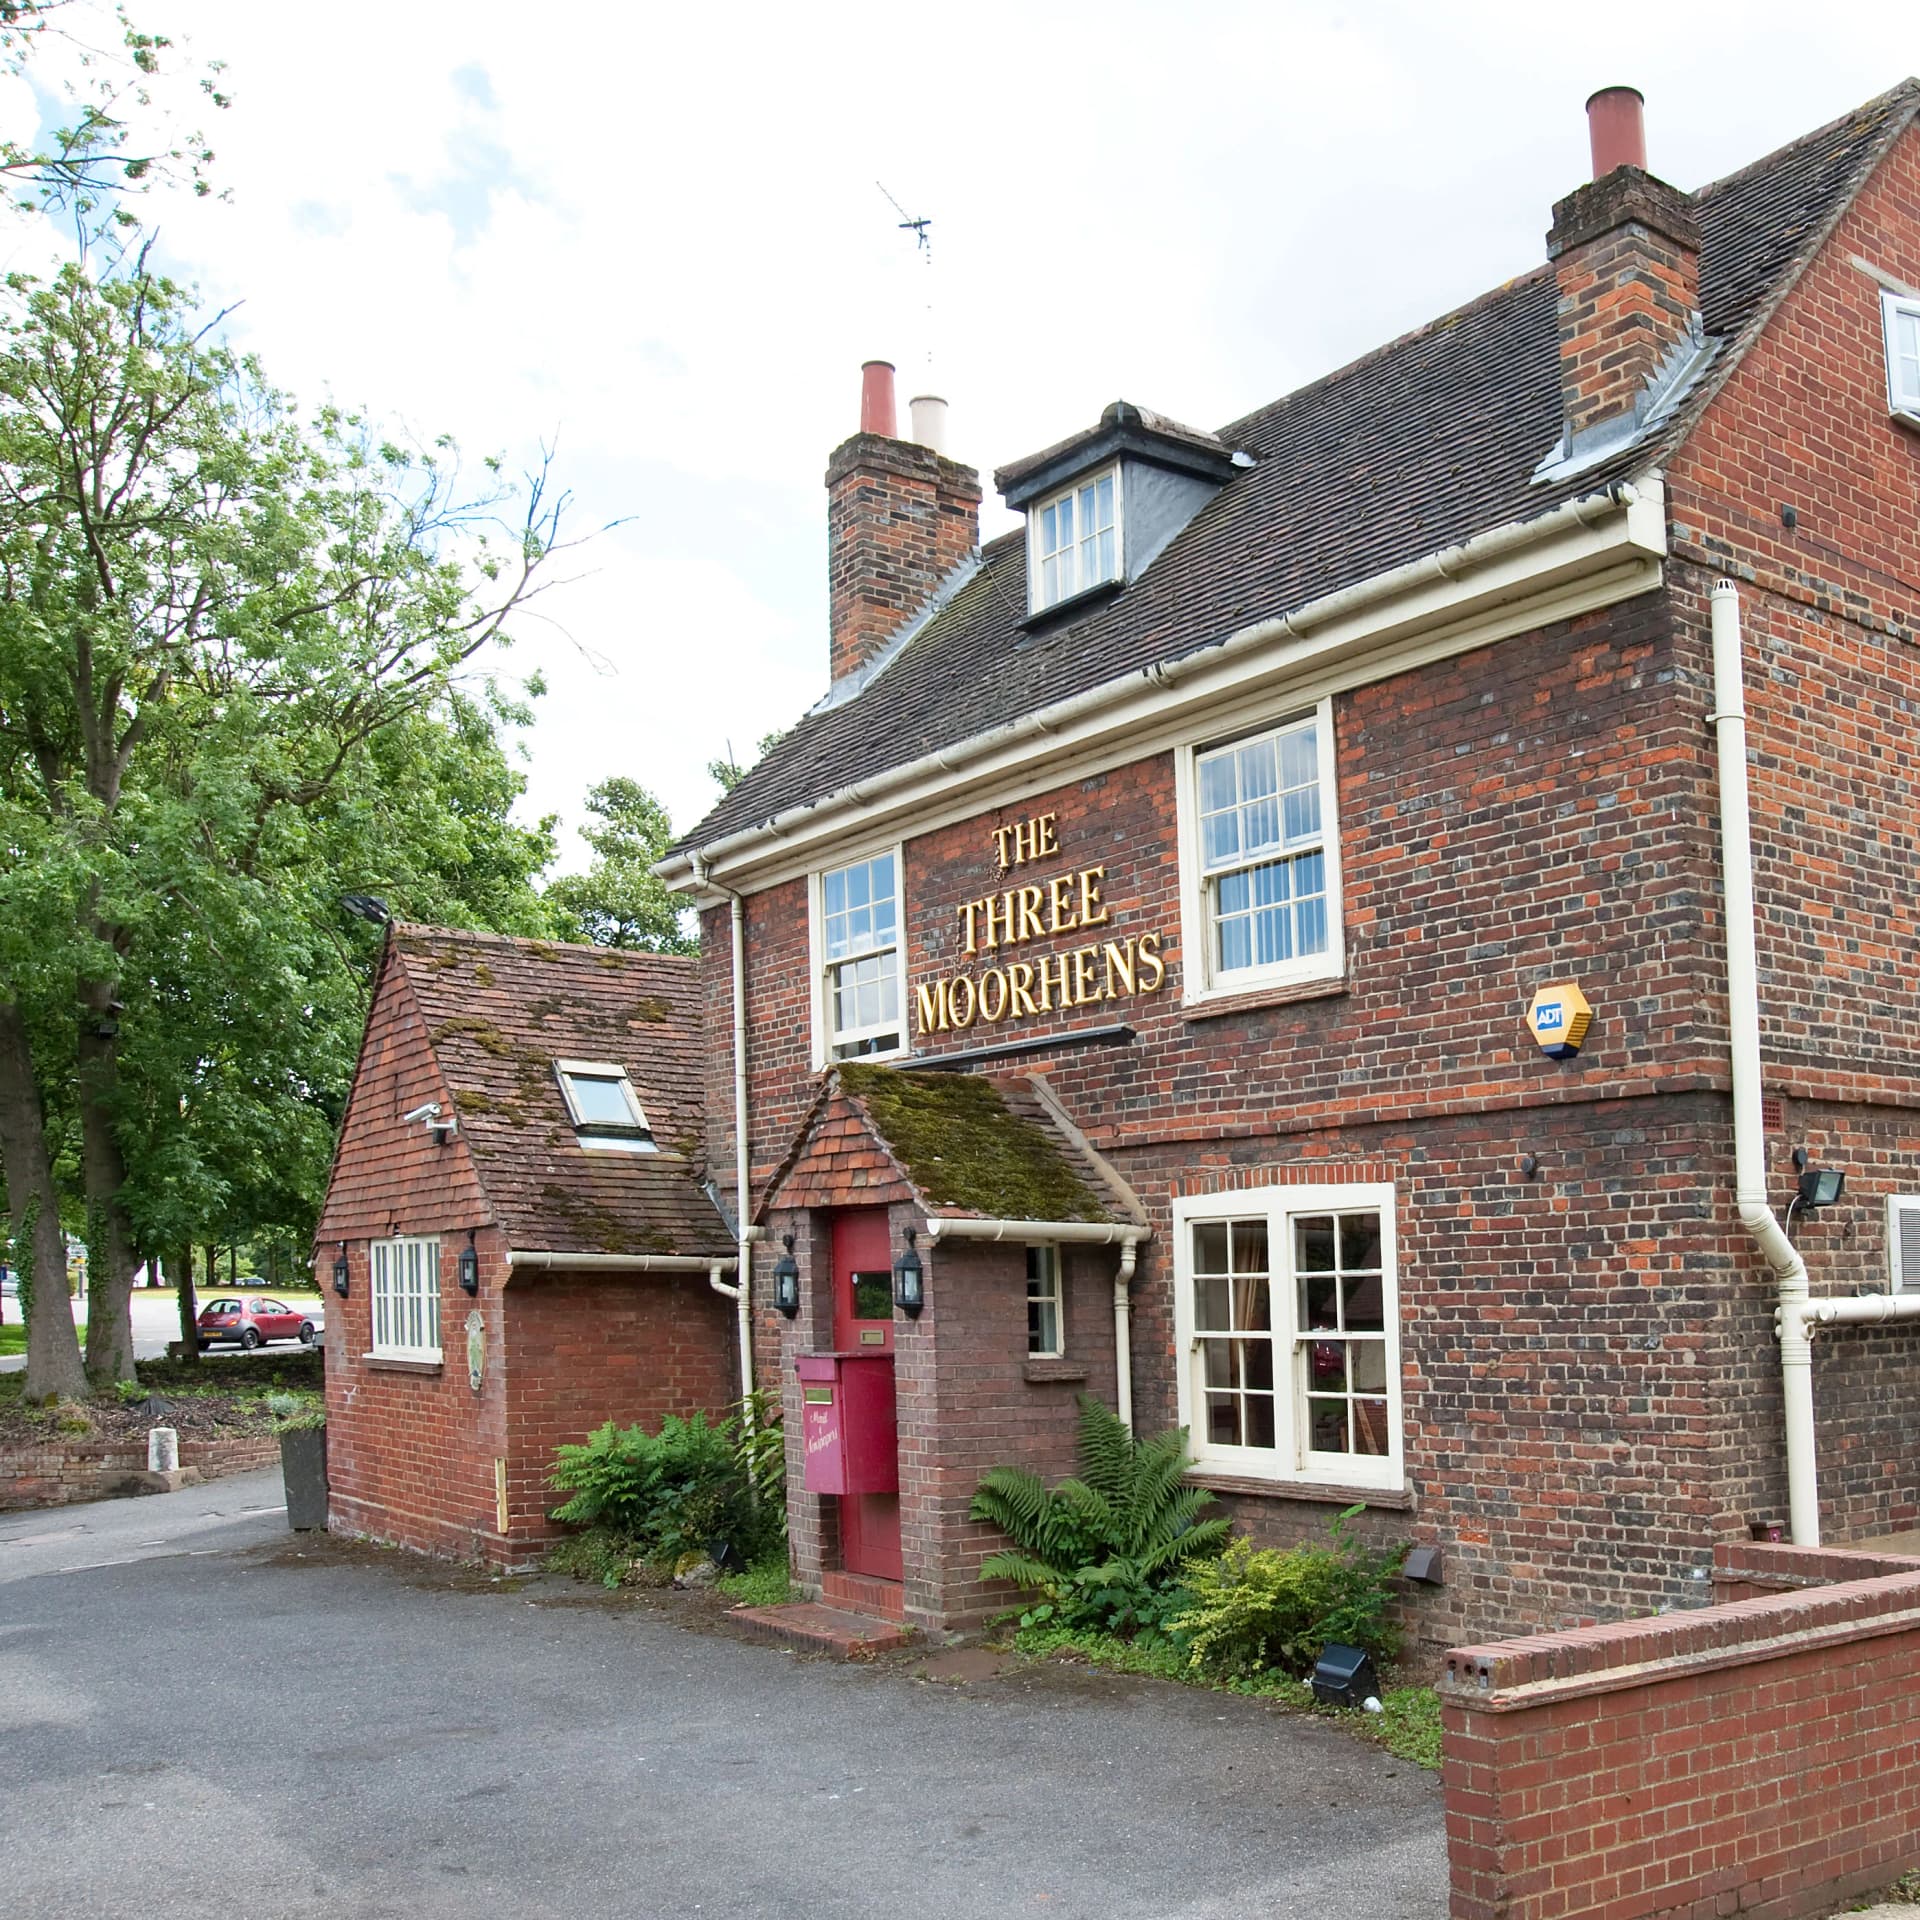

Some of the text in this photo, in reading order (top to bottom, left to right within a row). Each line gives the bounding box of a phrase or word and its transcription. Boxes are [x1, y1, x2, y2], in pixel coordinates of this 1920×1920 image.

[991, 812, 1060, 869] THE
[957, 865, 1109, 955] THREE
[916, 932, 1165, 1035] MOORHENS
[1537, 1007, 1562, 1025] ADT
